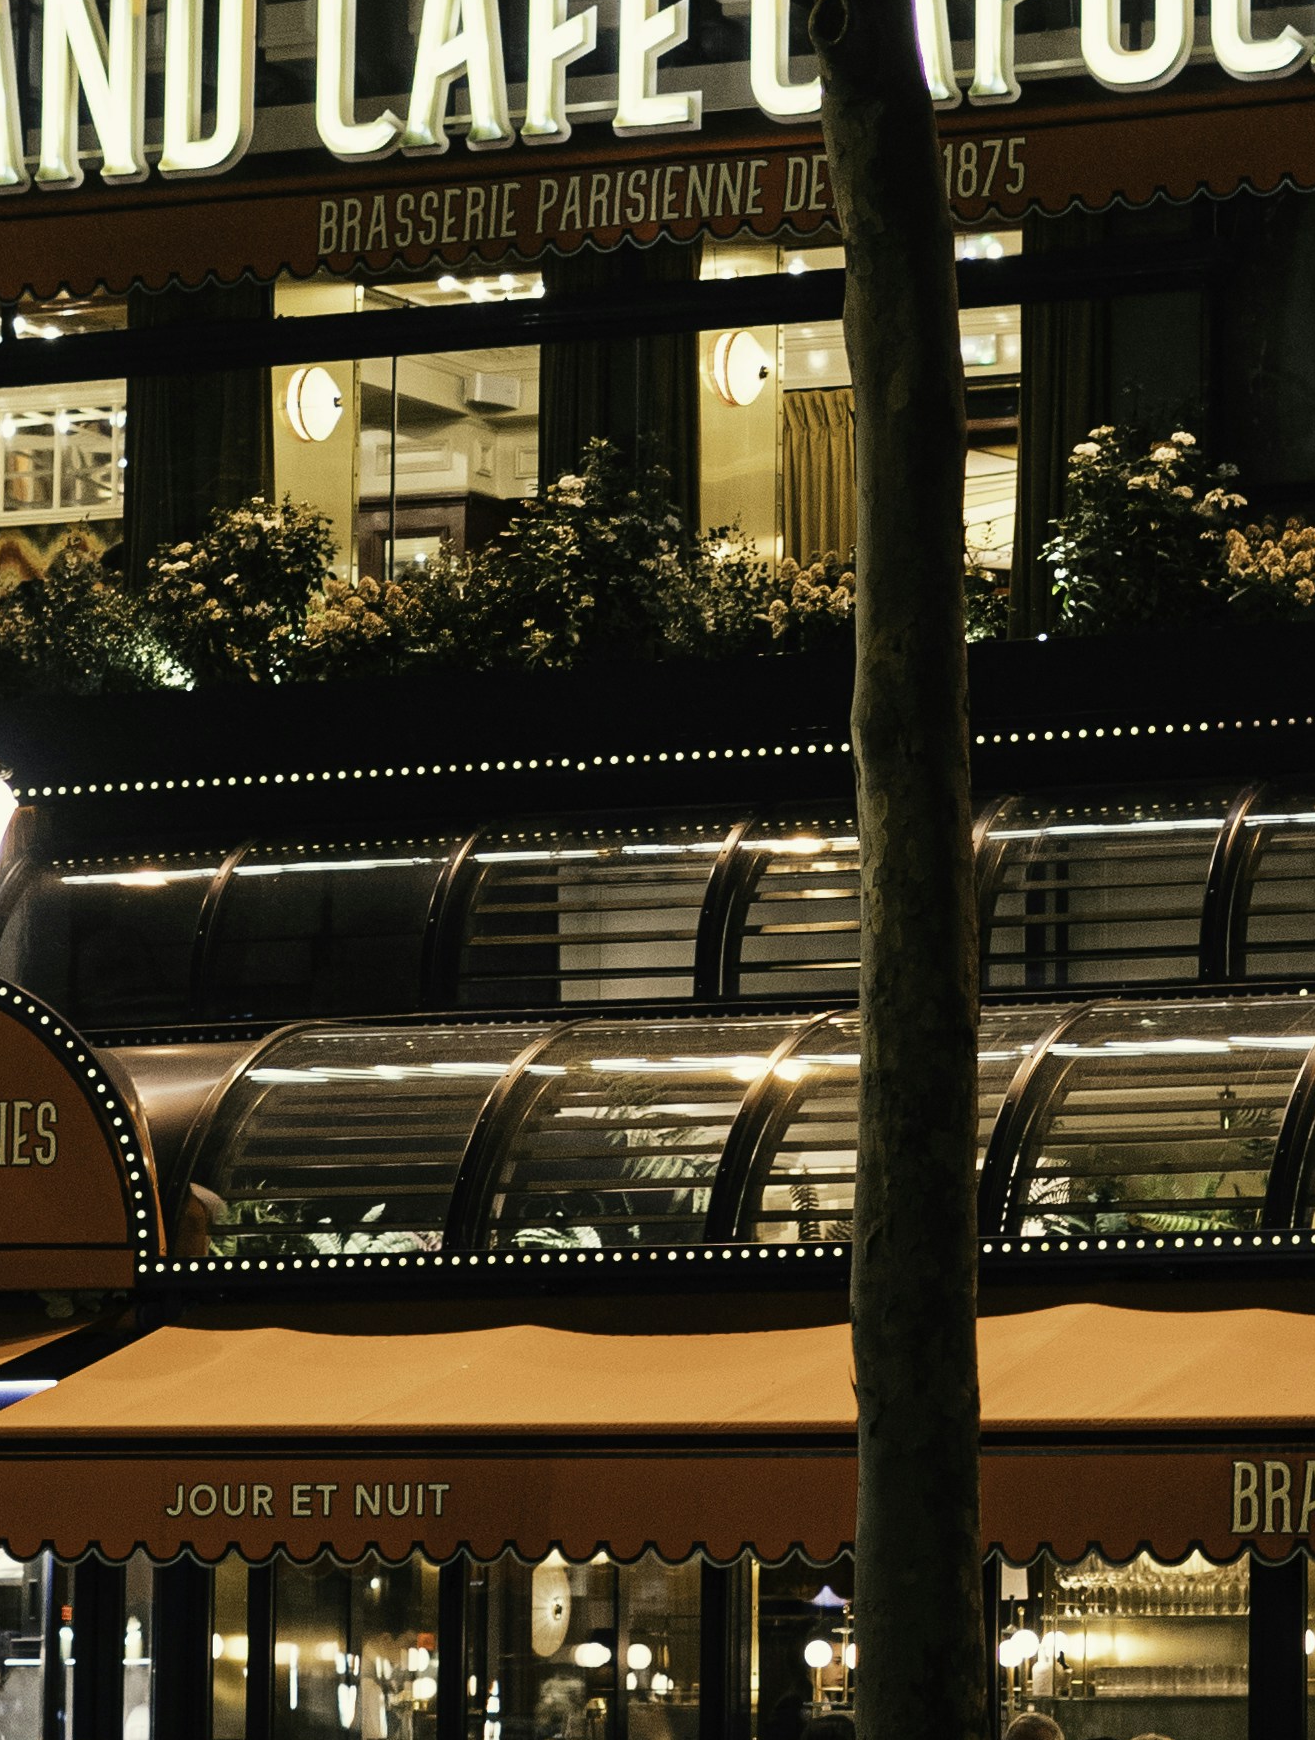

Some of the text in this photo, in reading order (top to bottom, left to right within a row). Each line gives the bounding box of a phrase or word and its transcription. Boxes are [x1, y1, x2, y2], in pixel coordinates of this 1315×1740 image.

[318, 182, 521, 256] BRASSERIE
[536, 159, 769, 235] PARISIENNE
[941, 136, 1027, 201] 1875
[165, 1483, 451, 1518] JOUR ET NUIT
